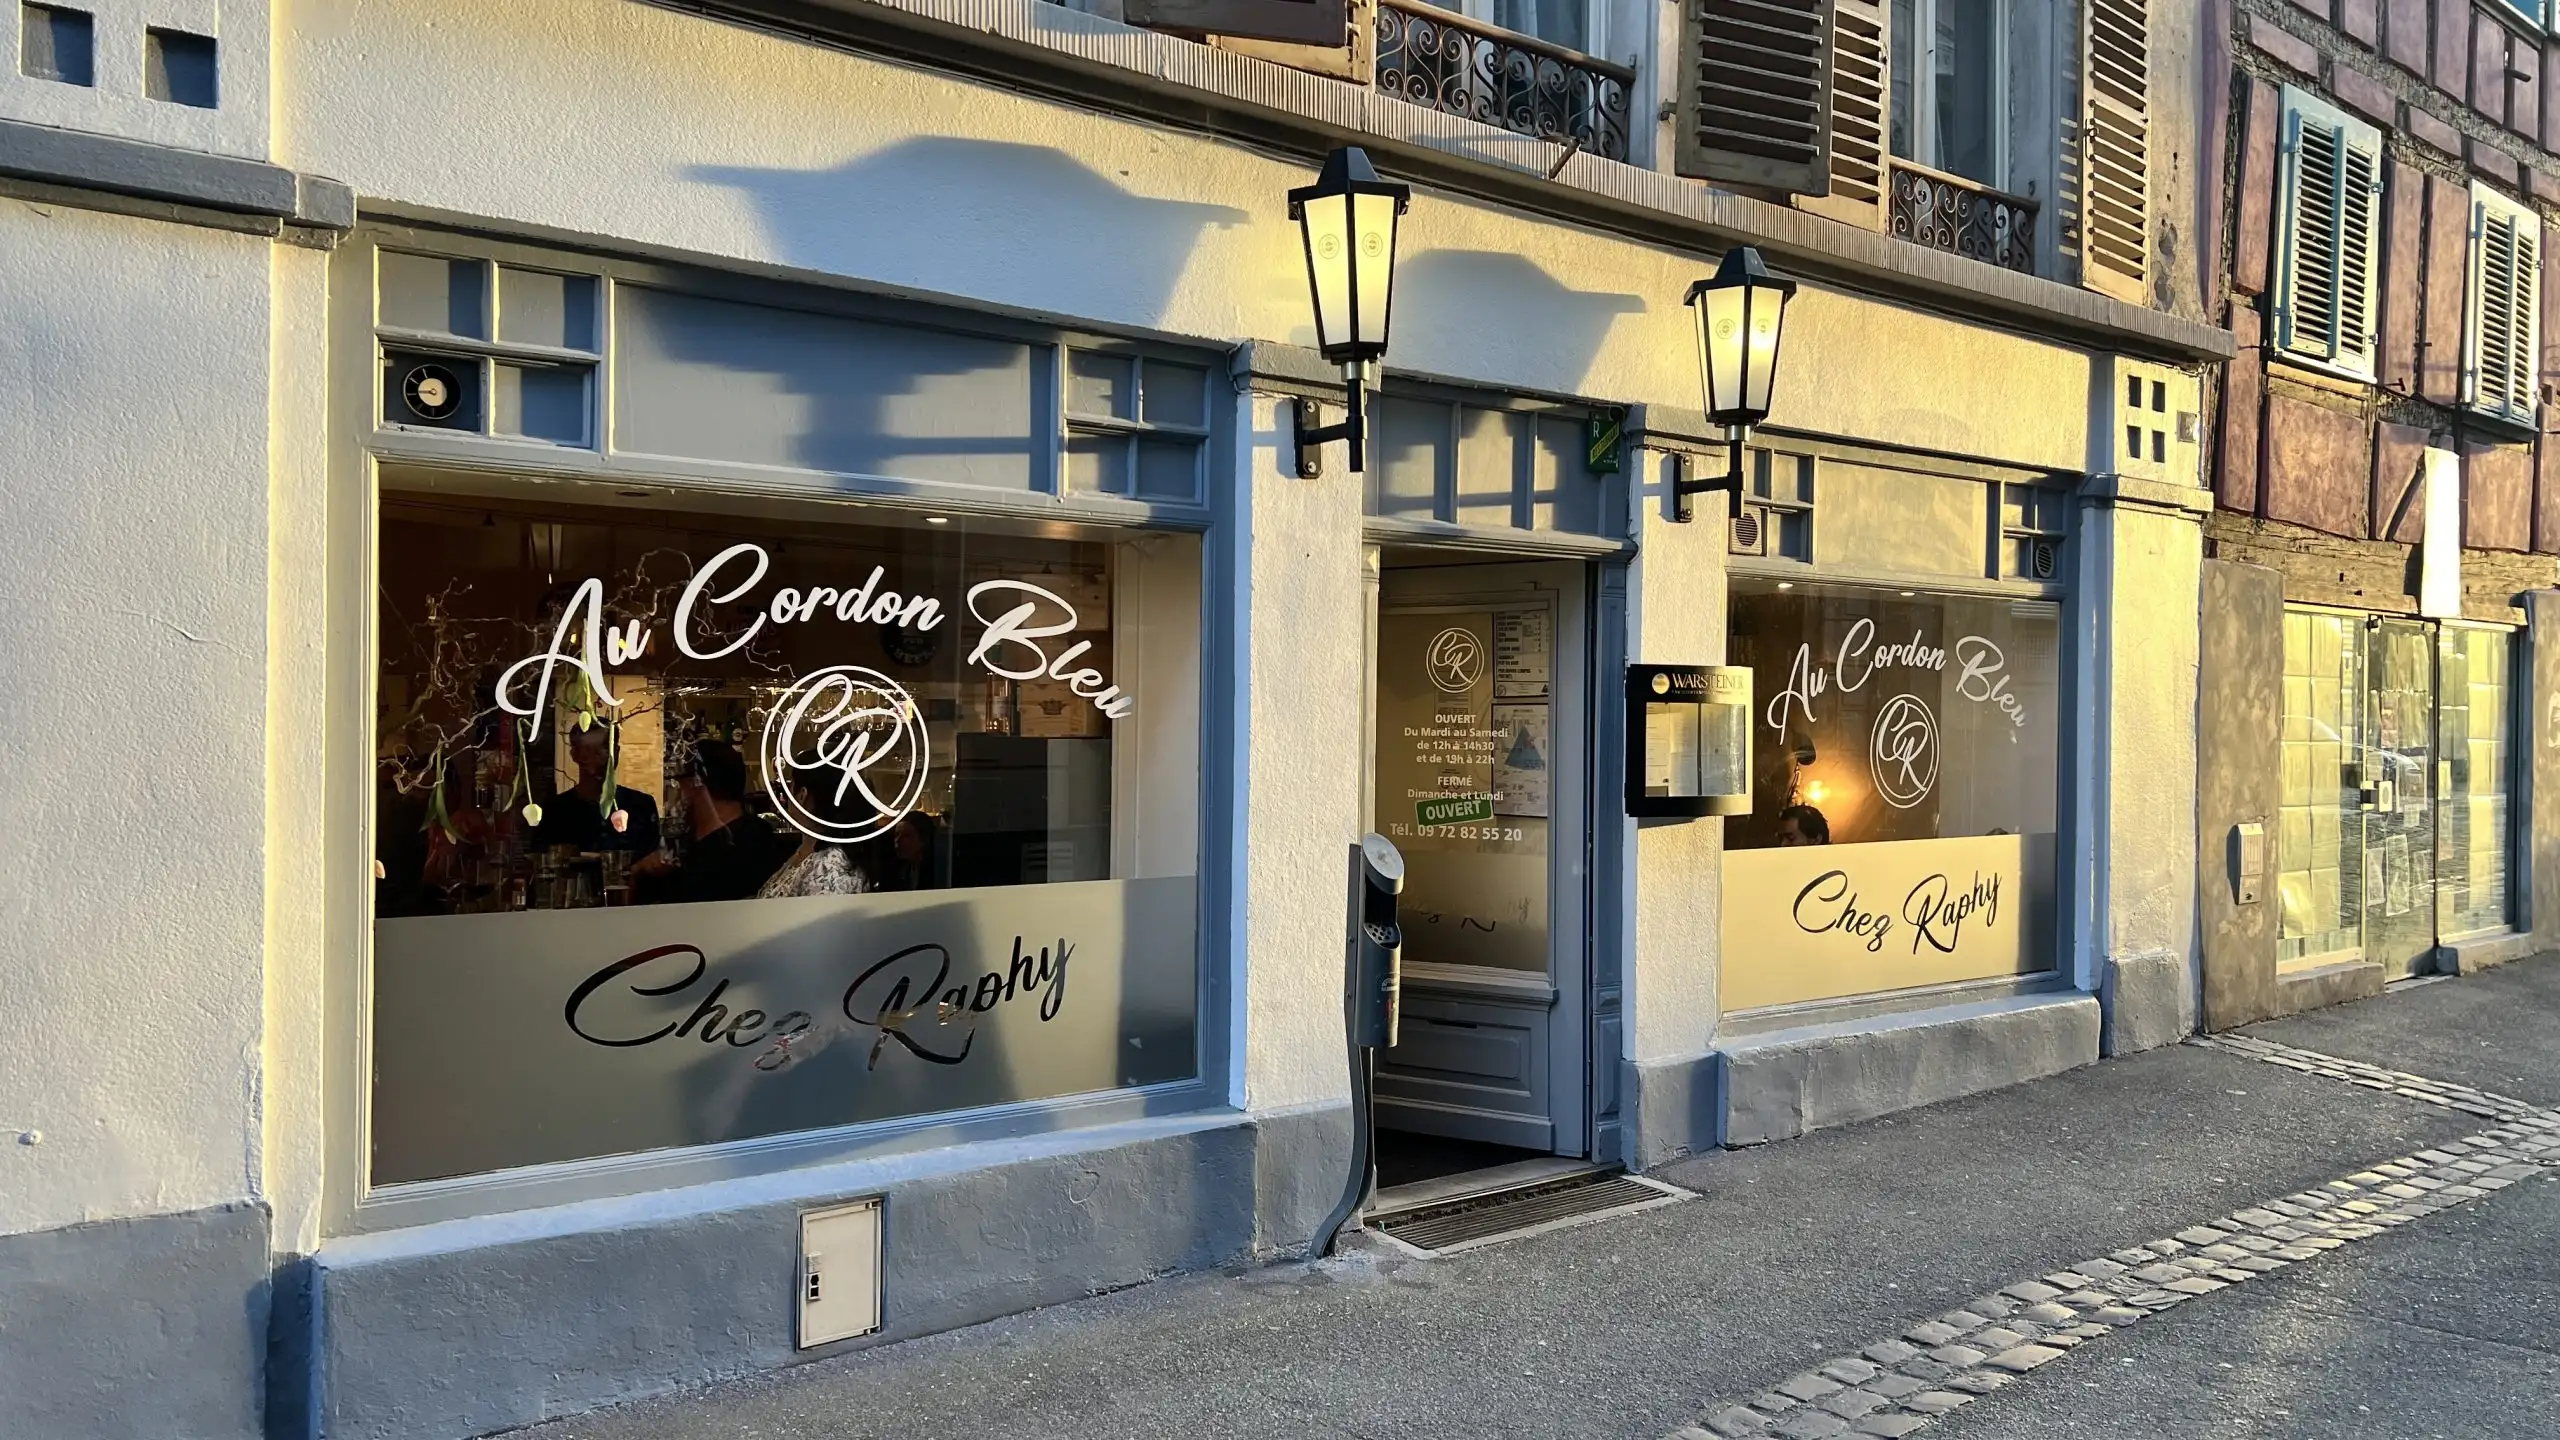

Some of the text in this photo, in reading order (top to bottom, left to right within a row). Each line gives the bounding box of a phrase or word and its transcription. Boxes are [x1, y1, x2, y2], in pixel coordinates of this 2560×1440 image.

[495, 543, 1132, 742] Au Cordon Bleu
[1672, 672, 1745, 689] WARSTEINER
[1767, 618, 2026, 745] Au Cordon Bleu
[1435, 714, 1477, 724] OUVERT
[1404, 727, 1508, 738] Du Mardi au Samedi
[1417, 741, 1495, 751] de 12h à 14h30
[1416, 754, 1495, 765] et de 19h à 22h
[1437, 775, 1473, 787] FERMÉ
[1407, 789, 1504, 801] Dimanche et Lundi
[1425, 800, 1482, 820] OUVERT
[1390, 822, 1523, 841] Tél. 09 72 82 55 20
[1792, 869, 2002, 955] Chez Raphy
[564, 936, 1075, 1072] Chez Raphy
